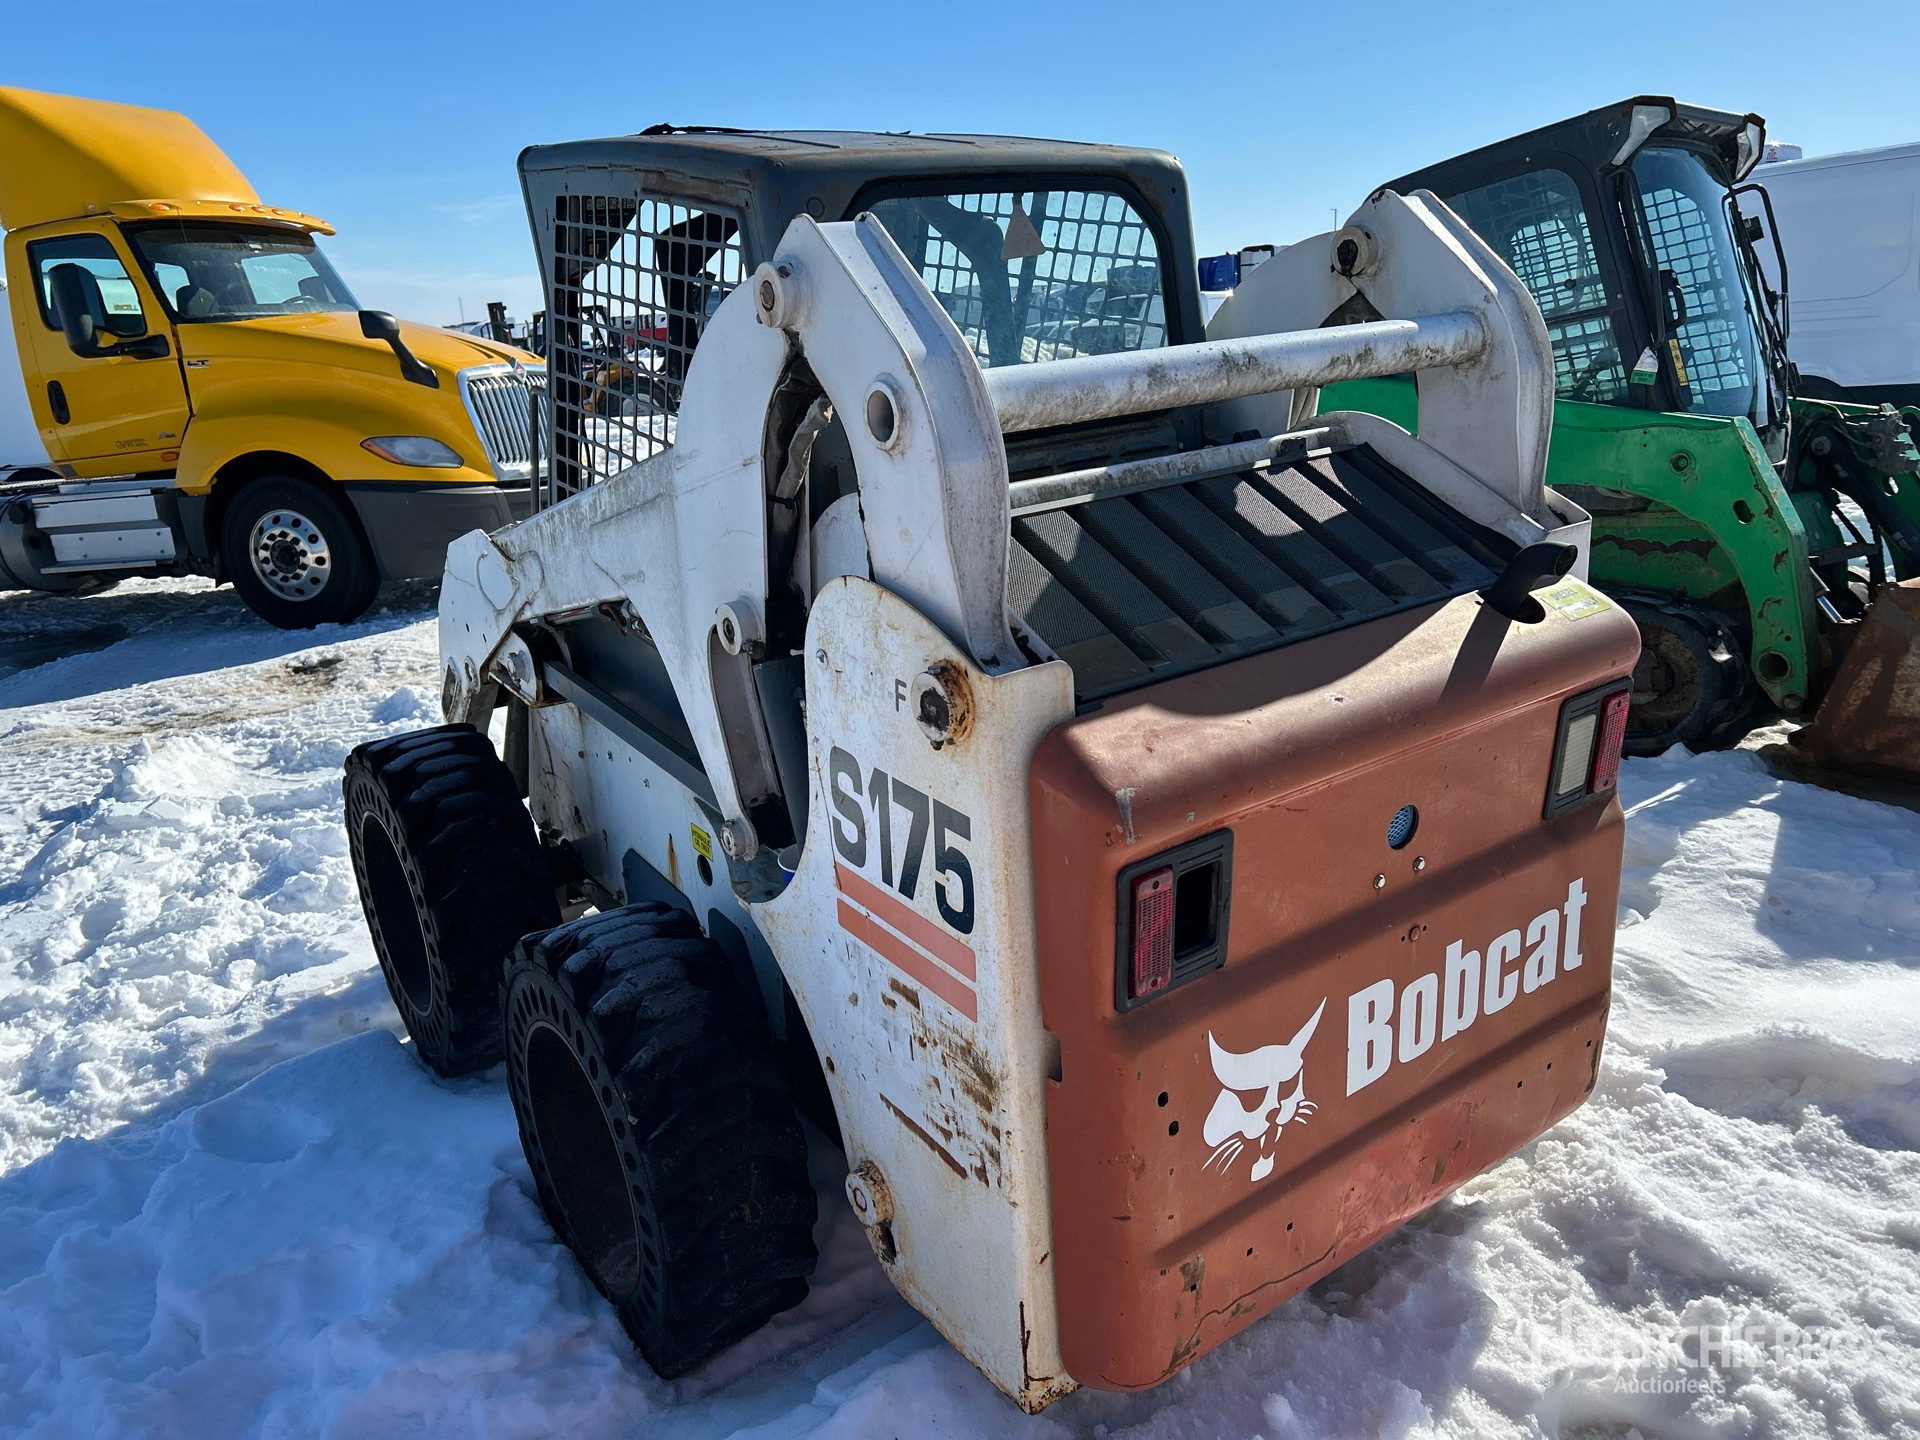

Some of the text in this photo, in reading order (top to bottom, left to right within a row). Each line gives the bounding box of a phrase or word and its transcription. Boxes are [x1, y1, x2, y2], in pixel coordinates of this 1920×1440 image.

[1549, 588, 1579, 601] DIESEL
[829, 745, 975, 935] S175
[1346, 877, 1588, 1097] Bobcat
